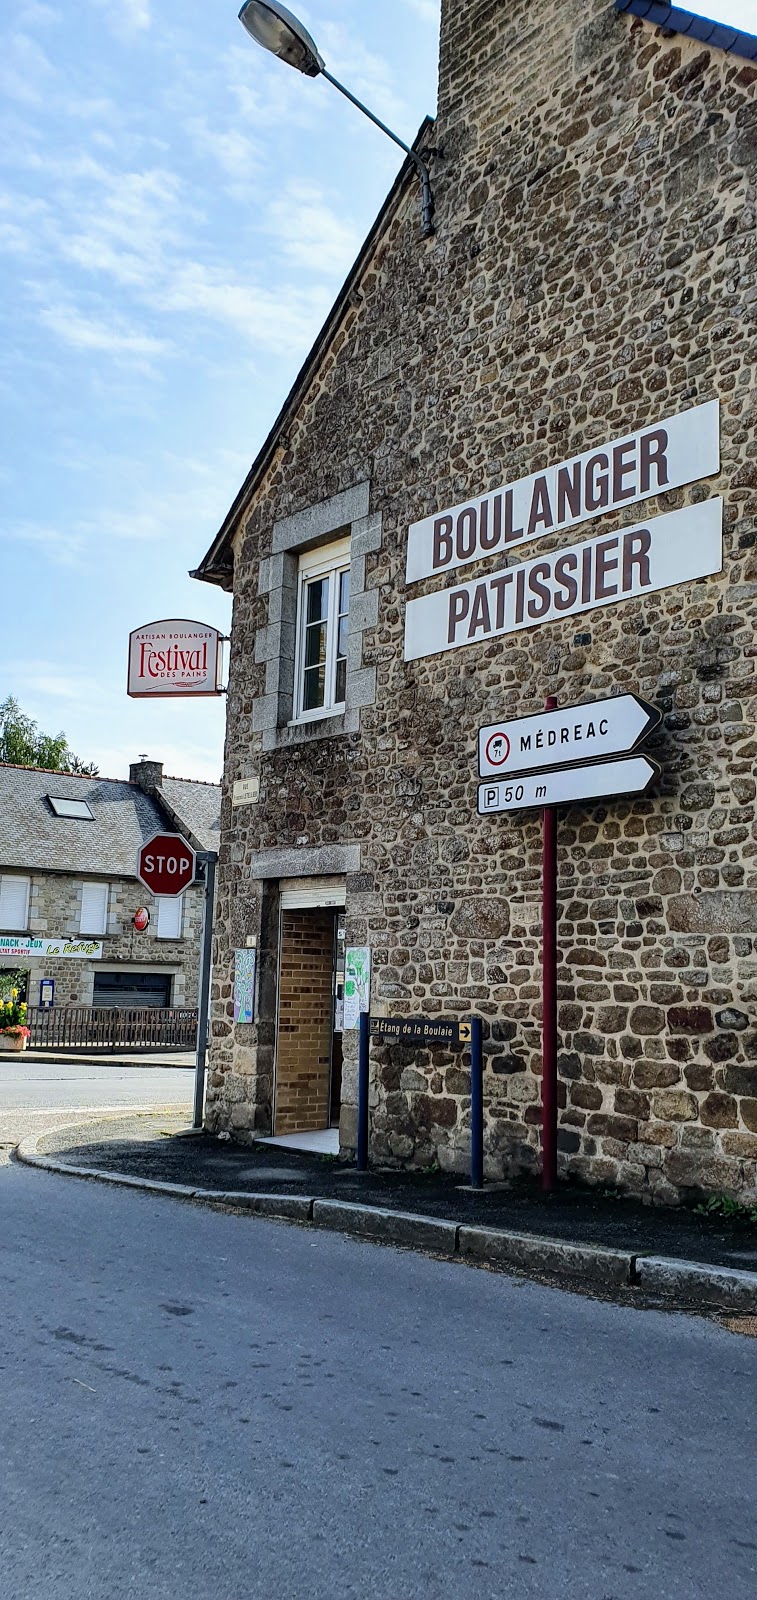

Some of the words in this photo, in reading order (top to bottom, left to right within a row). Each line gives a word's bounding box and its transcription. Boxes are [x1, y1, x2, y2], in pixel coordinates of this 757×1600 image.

[432, 428, 670, 569] BOULANGER
[447, 528, 652, 644] PATISSIER
[169, 632, 213, 640] BOULANGER
[138, 642, 208, 678] Festival
[519, 719, 609, 752] MÉDREAC
[504, 785, 524, 803] 50
[535, 785, 547, 799] m
[143, 854, 190, 875] STOP
[25, 940, 43, 949] JEUX
[46, 945, 60, 955] Le
[63, 942, 100, 955] Refuge
[380, 1021, 400, 1036] Étang
[402, 1023, 412, 1034] de
[414, 1024, 421, 1034] la
[424, 1025, 453, 1037] Boulaie
